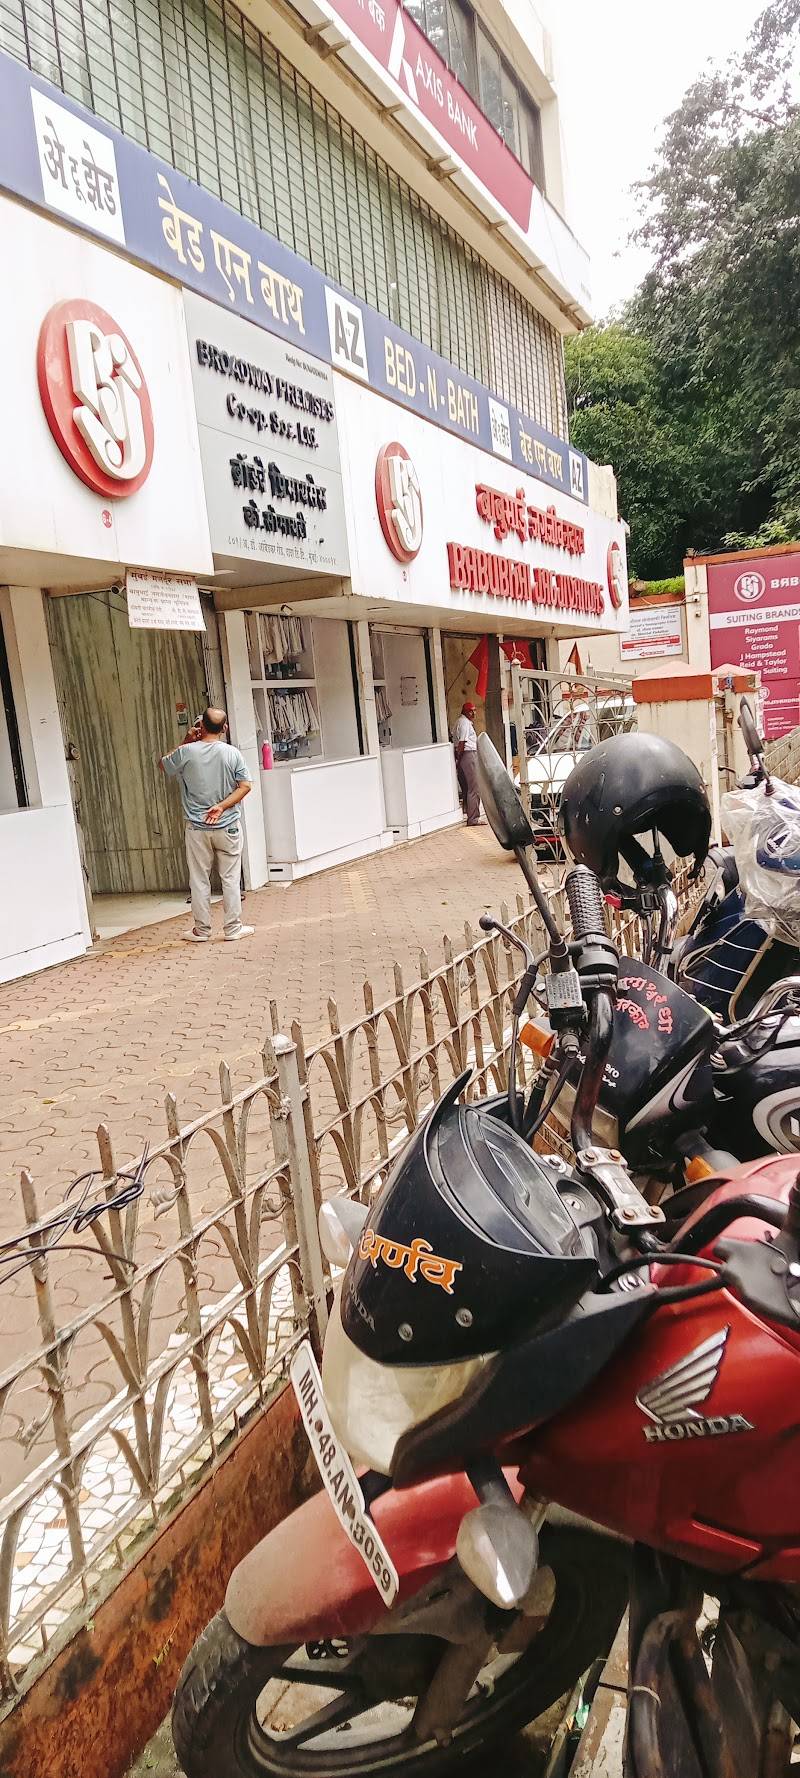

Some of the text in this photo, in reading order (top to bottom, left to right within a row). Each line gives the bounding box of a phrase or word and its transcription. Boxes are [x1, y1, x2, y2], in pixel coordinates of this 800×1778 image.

[415, 52, 479, 152] AXIS BANK
[81, 139, 117, 216] झेड
[157, 172, 306, 336] बेड एन बाथ
[195, 338, 335, 423] BROADWAY PREMISES
[384, 336, 417, 398] BED
[426, 365, 438, 412] N
[447, 378, 480, 435] BATH
[518, 417, 533, 465] बेड
[546, 447, 564, 482] बाथ
[474, 482, 528, 543] बाबुभाई
[446, 541, 533, 601] BABUBHAI
[531, 567, 605, 615] JAGJIVANDAS
[726, 611, 763, 624] SUITING
[744, 625, 779, 636] Raymond
[745, 634, 778, 644] Siyarams
[740, 658, 787, 669] Reid & Taylor
[744, 649, 786, 661] Hampstead
[750, 642, 774, 651] Grado
[762, 666, 788, 676] Suiting
[604, 1063, 620, 1079] ero
[359, 1228, 463, 1295] अर्णव
[641, 1413, 755, 1443] HONDA
